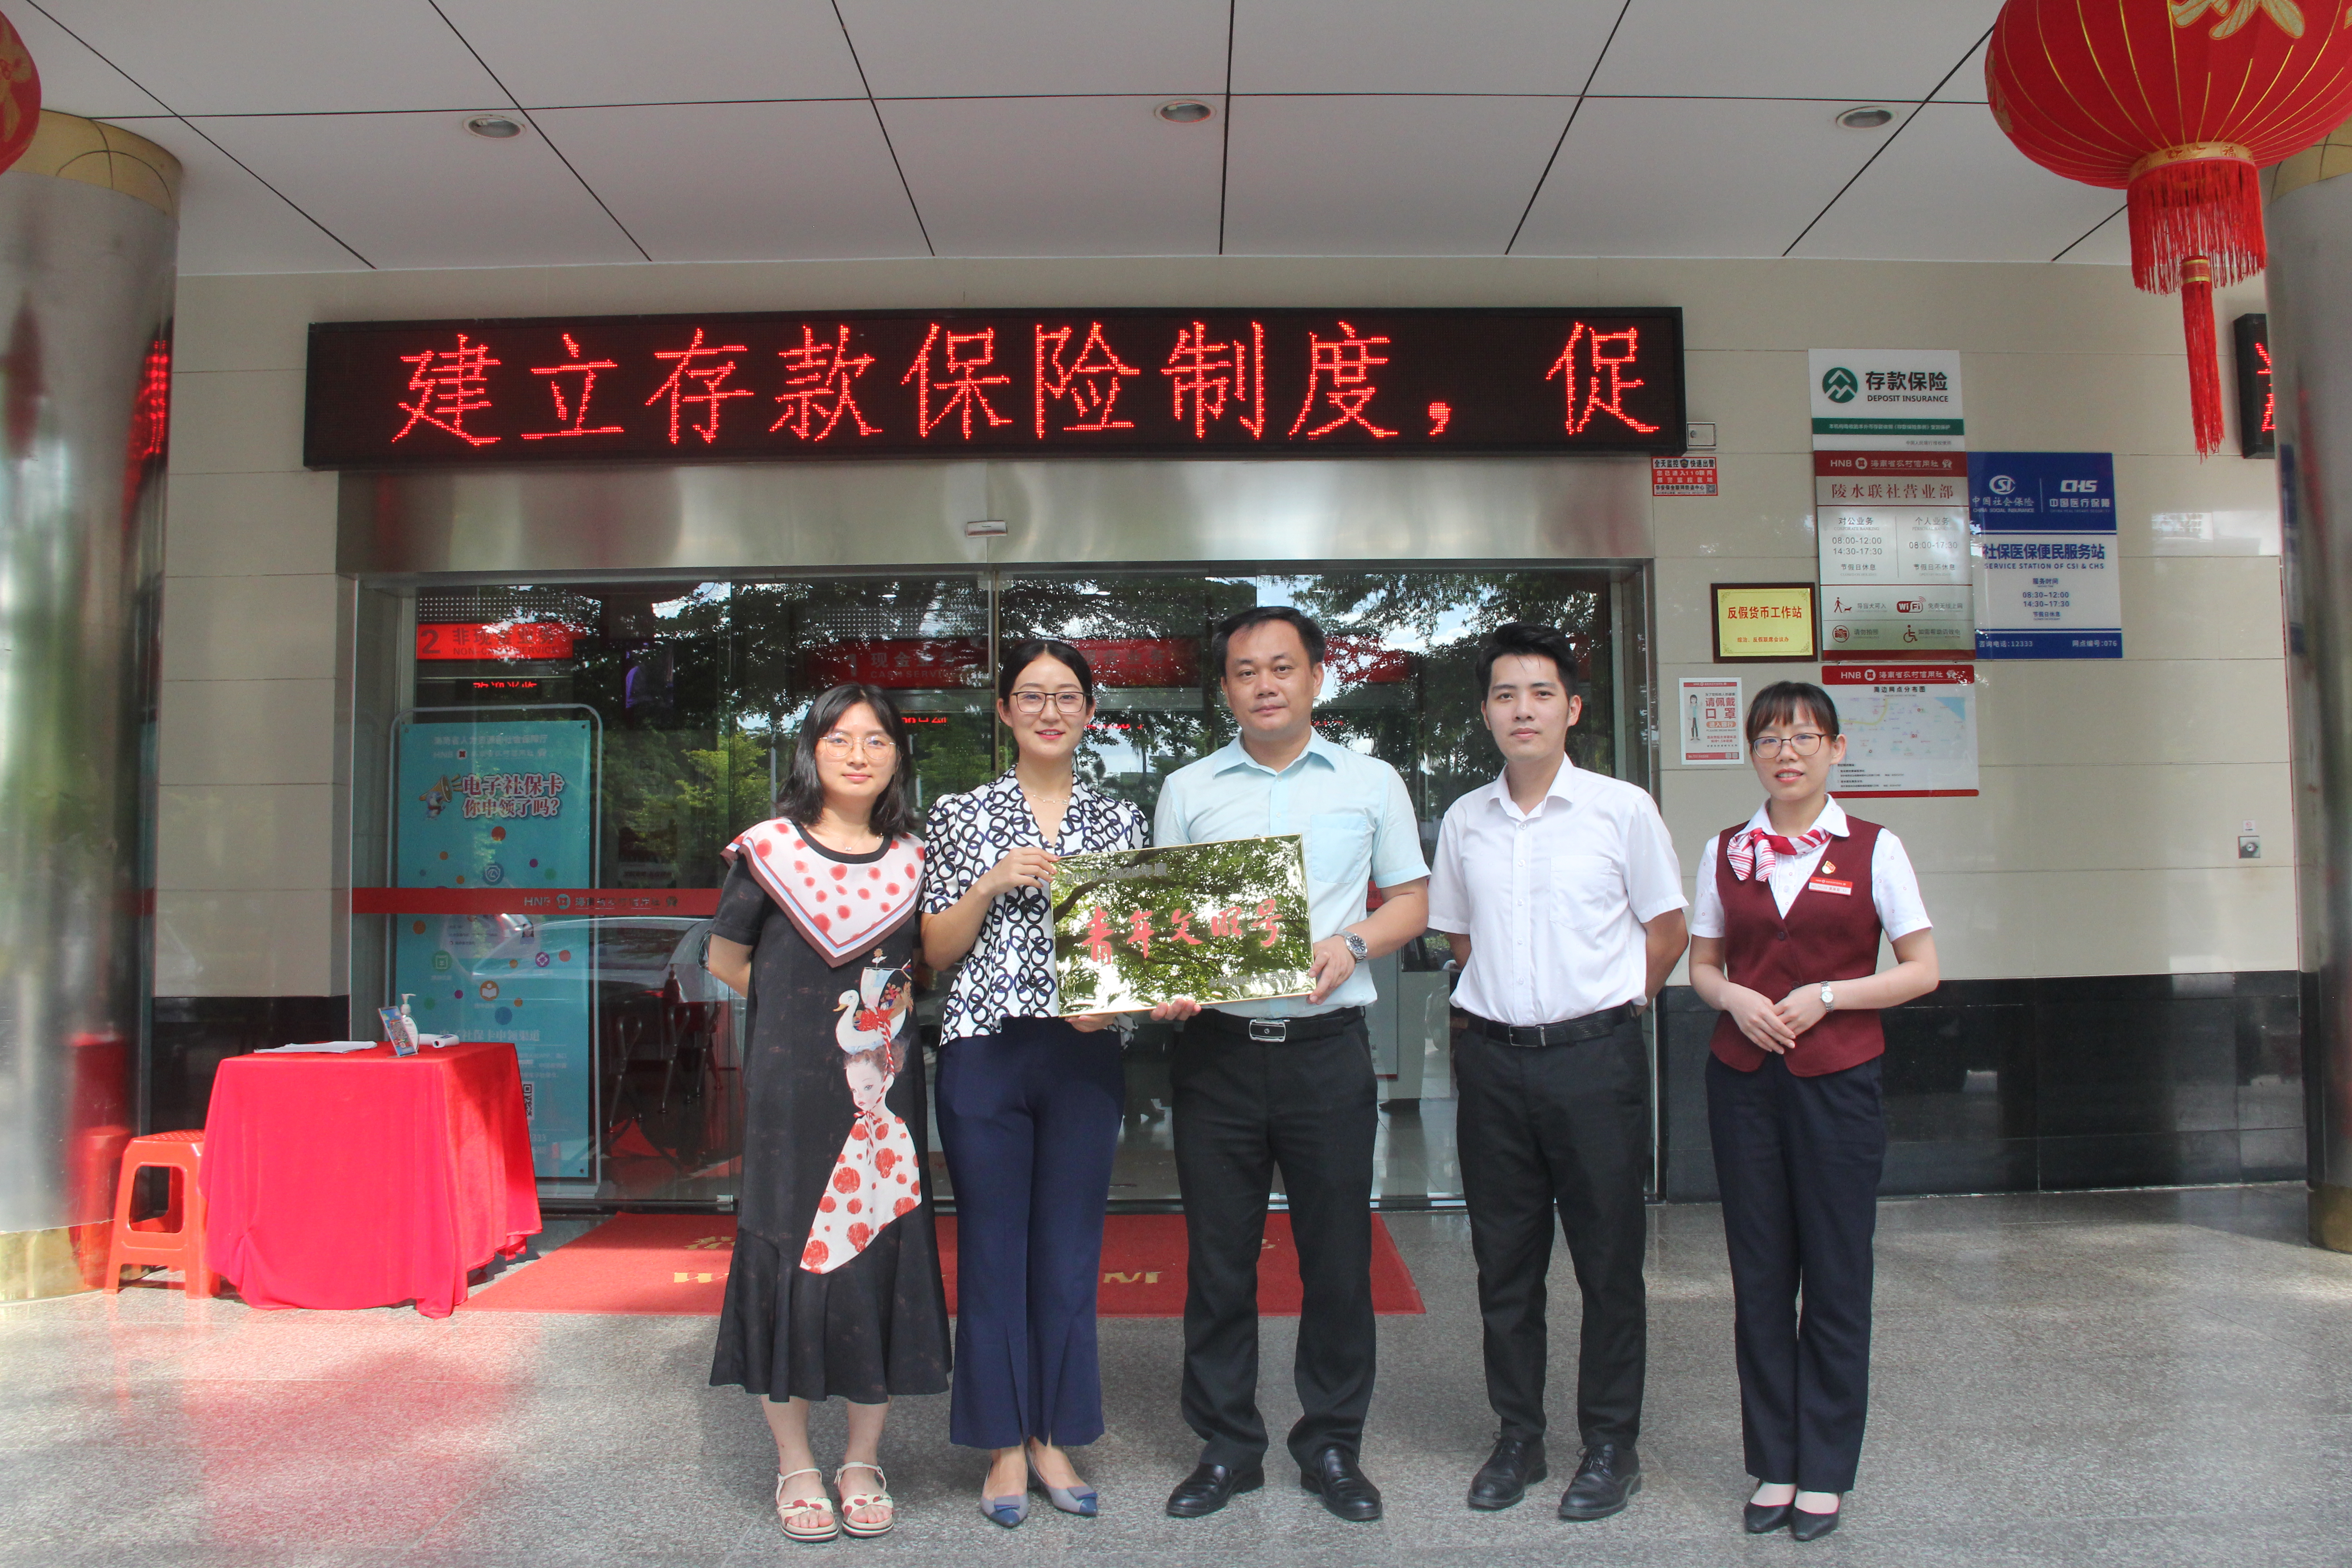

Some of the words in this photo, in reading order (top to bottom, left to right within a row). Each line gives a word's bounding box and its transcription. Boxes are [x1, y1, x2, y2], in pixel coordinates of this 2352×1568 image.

[1866, 371, 1948, 391] 存款保险
[1655, 459, 1679, 468] 全天监控
[1690, 459, 1714, 468] 快速出警
[1832, 484, 1953, 499] 陵水联社营业部
[2060, 480, 2098, 492] CHS
[1972, 496, 2034, 507] 中国社会保险
[2049, 498, 2110, 507] 中国医疗保障
[1838, 517, 1874, 525] 对公业务
[1915, 517, 1950, 526] 个人业务
[1984, 543, 2105, 560] 社保医保便民服务站
[1728, 606, 1802, 619] 反假货币工作站
[1899, 602, 1921, 611] WiFi
[421, 629, 441, 654] 2
[1705, 697, 1735, 706] 请佩戴
[463, 774, 564, 796] 电子社保卡
[1082, 898, 1282, 965] 青年文明号
